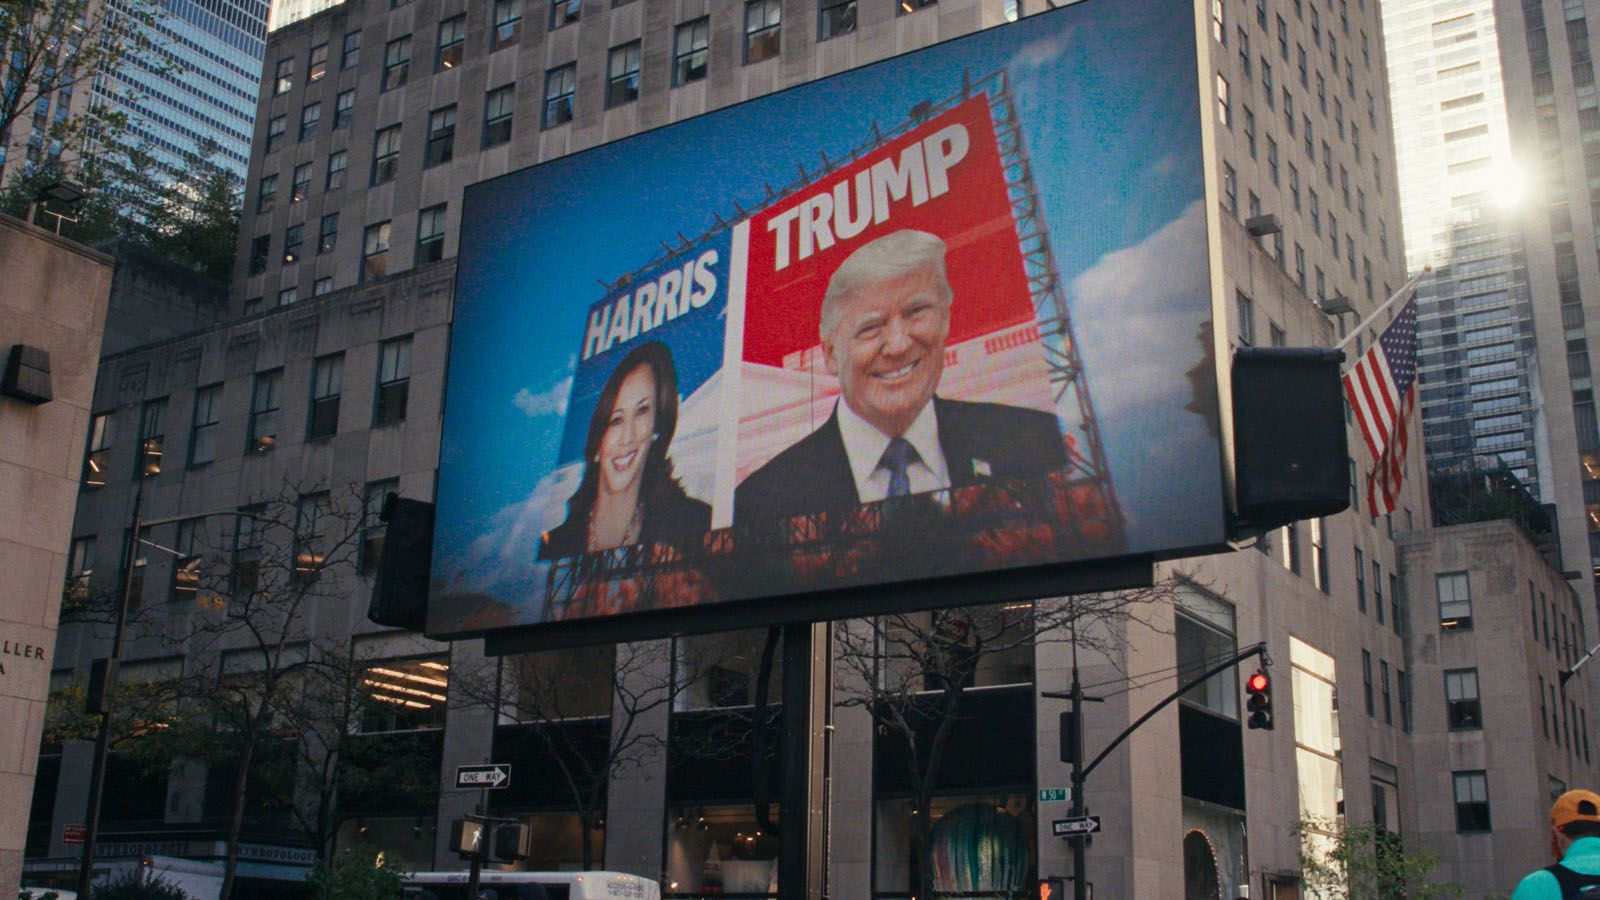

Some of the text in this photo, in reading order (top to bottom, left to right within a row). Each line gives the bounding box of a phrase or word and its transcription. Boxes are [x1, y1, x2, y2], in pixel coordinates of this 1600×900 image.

[767, 123, 970, 272] TRUMP
[581, 249, 720, 361] HARRIS
[463, 772, 502, 782] ONE WAY
[1048, 788, 1057, 800] 50
[1058, 821, 1093, 832] ONE WAY
